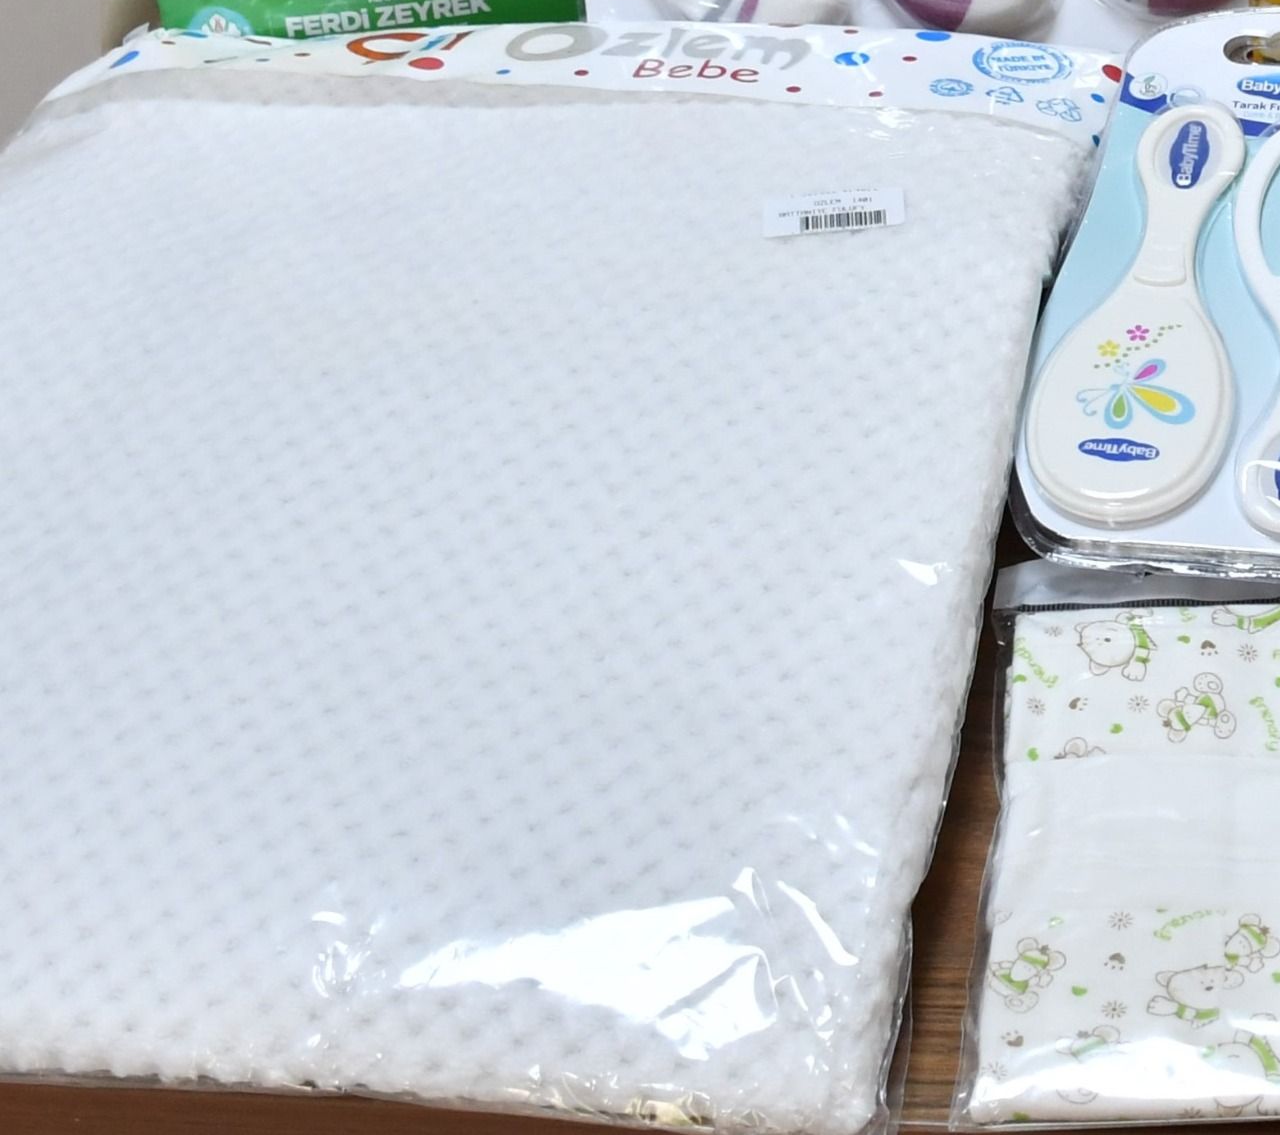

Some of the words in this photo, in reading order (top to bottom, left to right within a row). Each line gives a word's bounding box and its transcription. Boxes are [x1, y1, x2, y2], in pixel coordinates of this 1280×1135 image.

[285, 9, 371, 38] FERDİ
[633, 58, 760, 83] Bebe
[1232, 101, 1266, 110] Tarak
[1175, 123, 1202, 186] BabyTime
[1083, 441, 1157, 461] BabyTime
